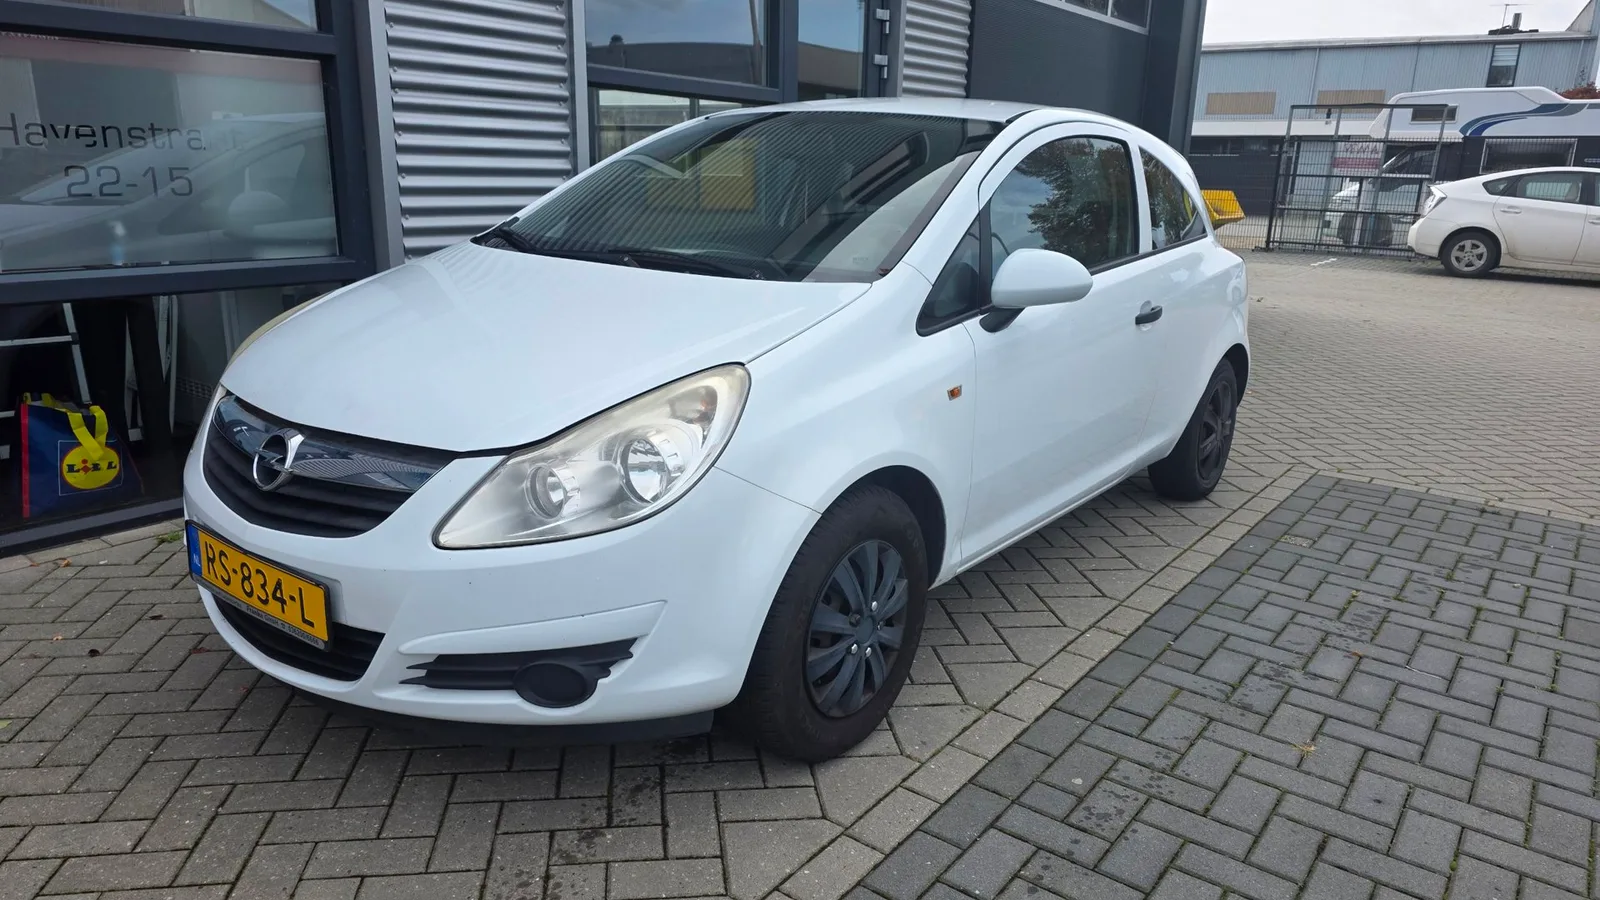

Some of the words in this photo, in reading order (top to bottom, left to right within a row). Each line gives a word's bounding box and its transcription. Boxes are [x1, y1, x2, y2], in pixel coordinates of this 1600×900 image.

[0, 113, 244, 151] Havenstra
[64, 165, 193, 197] 22-15
[204, 541, 315, 628] RS-834-L
